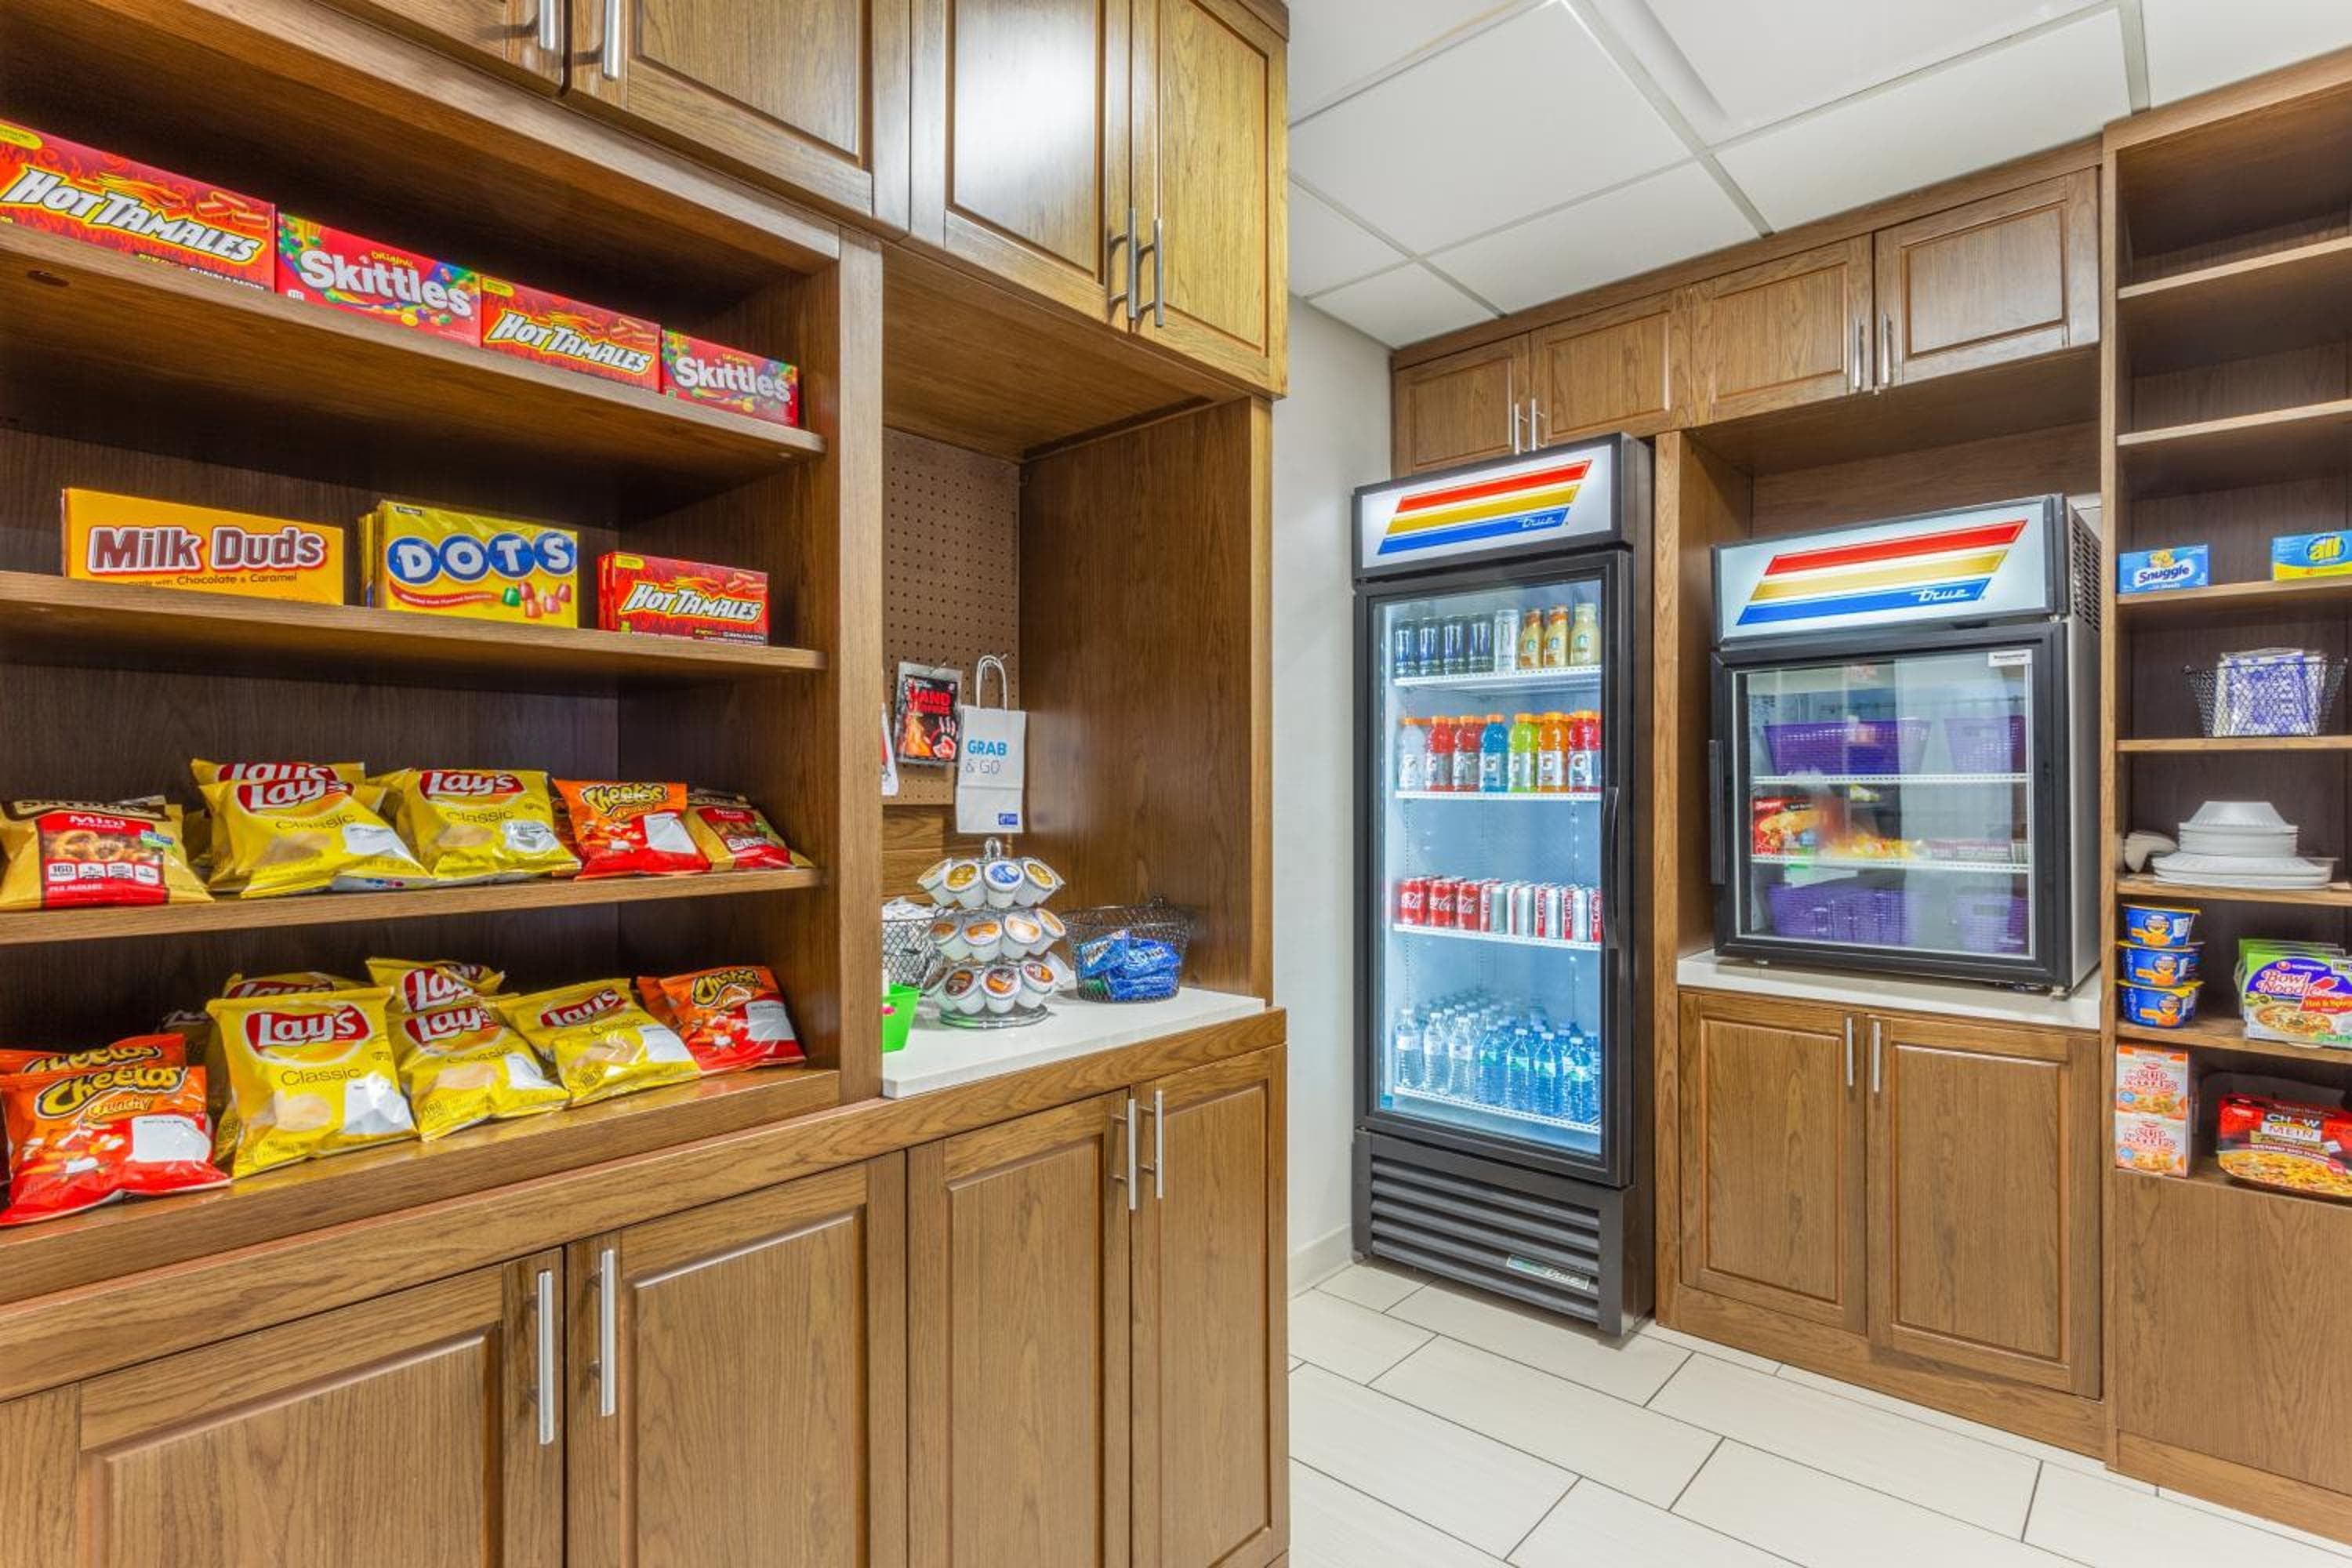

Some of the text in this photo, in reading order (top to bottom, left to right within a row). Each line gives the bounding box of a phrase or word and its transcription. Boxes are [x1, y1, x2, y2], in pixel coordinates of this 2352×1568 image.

[1, 167, 263, 262] HOT TAMALES
[300, 250, 472, 317] Skittles
[489, 311, 653, 372] HOT TAMALES
[675, 357, 791, 402] Skittles
[89, 527, 325, 570] Milk Duds
[397, 536, 571, 578] DOTS
[2309, 536, 2342, 561] all
[176, 575, 237, 585] Chocolate
[250, 572, 297, 583] Caramel
[2139, 566, 2190, 583] Snuggle
[624, 583, 762, 621] HOT TAMALES
[967, 739, 1007, 757] GRAB
[965, 759, 1001, 775] & GO
[426, 771, 514, 797] Lay's
[584, 784, 664, 813] Cheetos
[447, 809, 515, 824] Classic
[2261, 970, 2312, 984] Bowl
[258, 1010, 358, 1047] Lay's
[280, 1066, 361, 1086] Classic
[41, 1067, 185, 1116] Cheetos
[2268, 1124, 2314, 1139] MEIN
